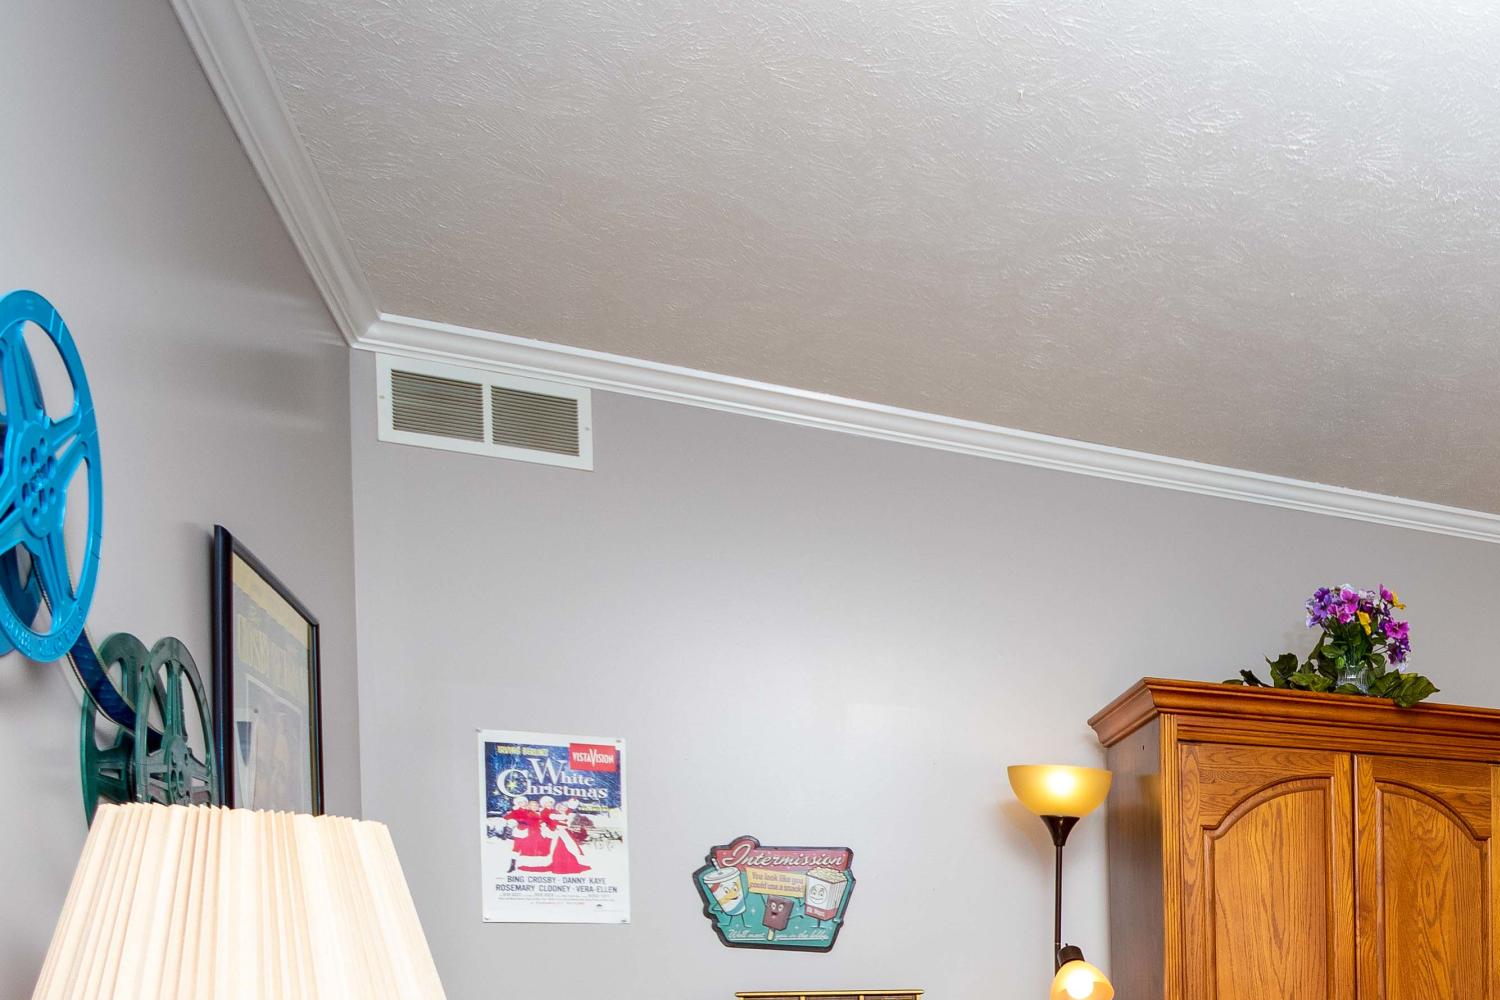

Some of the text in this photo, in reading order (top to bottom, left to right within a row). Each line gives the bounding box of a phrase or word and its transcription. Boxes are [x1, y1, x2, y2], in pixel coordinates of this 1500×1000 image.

[497, 768, 608, 799] Christmas
[527, 757, 594, 787] White
[722, 844, 844, 867] Intermission
[496, 884, 535, 892] ROSEMARY
[539, 884, 571, 893] CLOONEY
[507, 876, 606, 885] BING CROSBY DANNY KAYE
